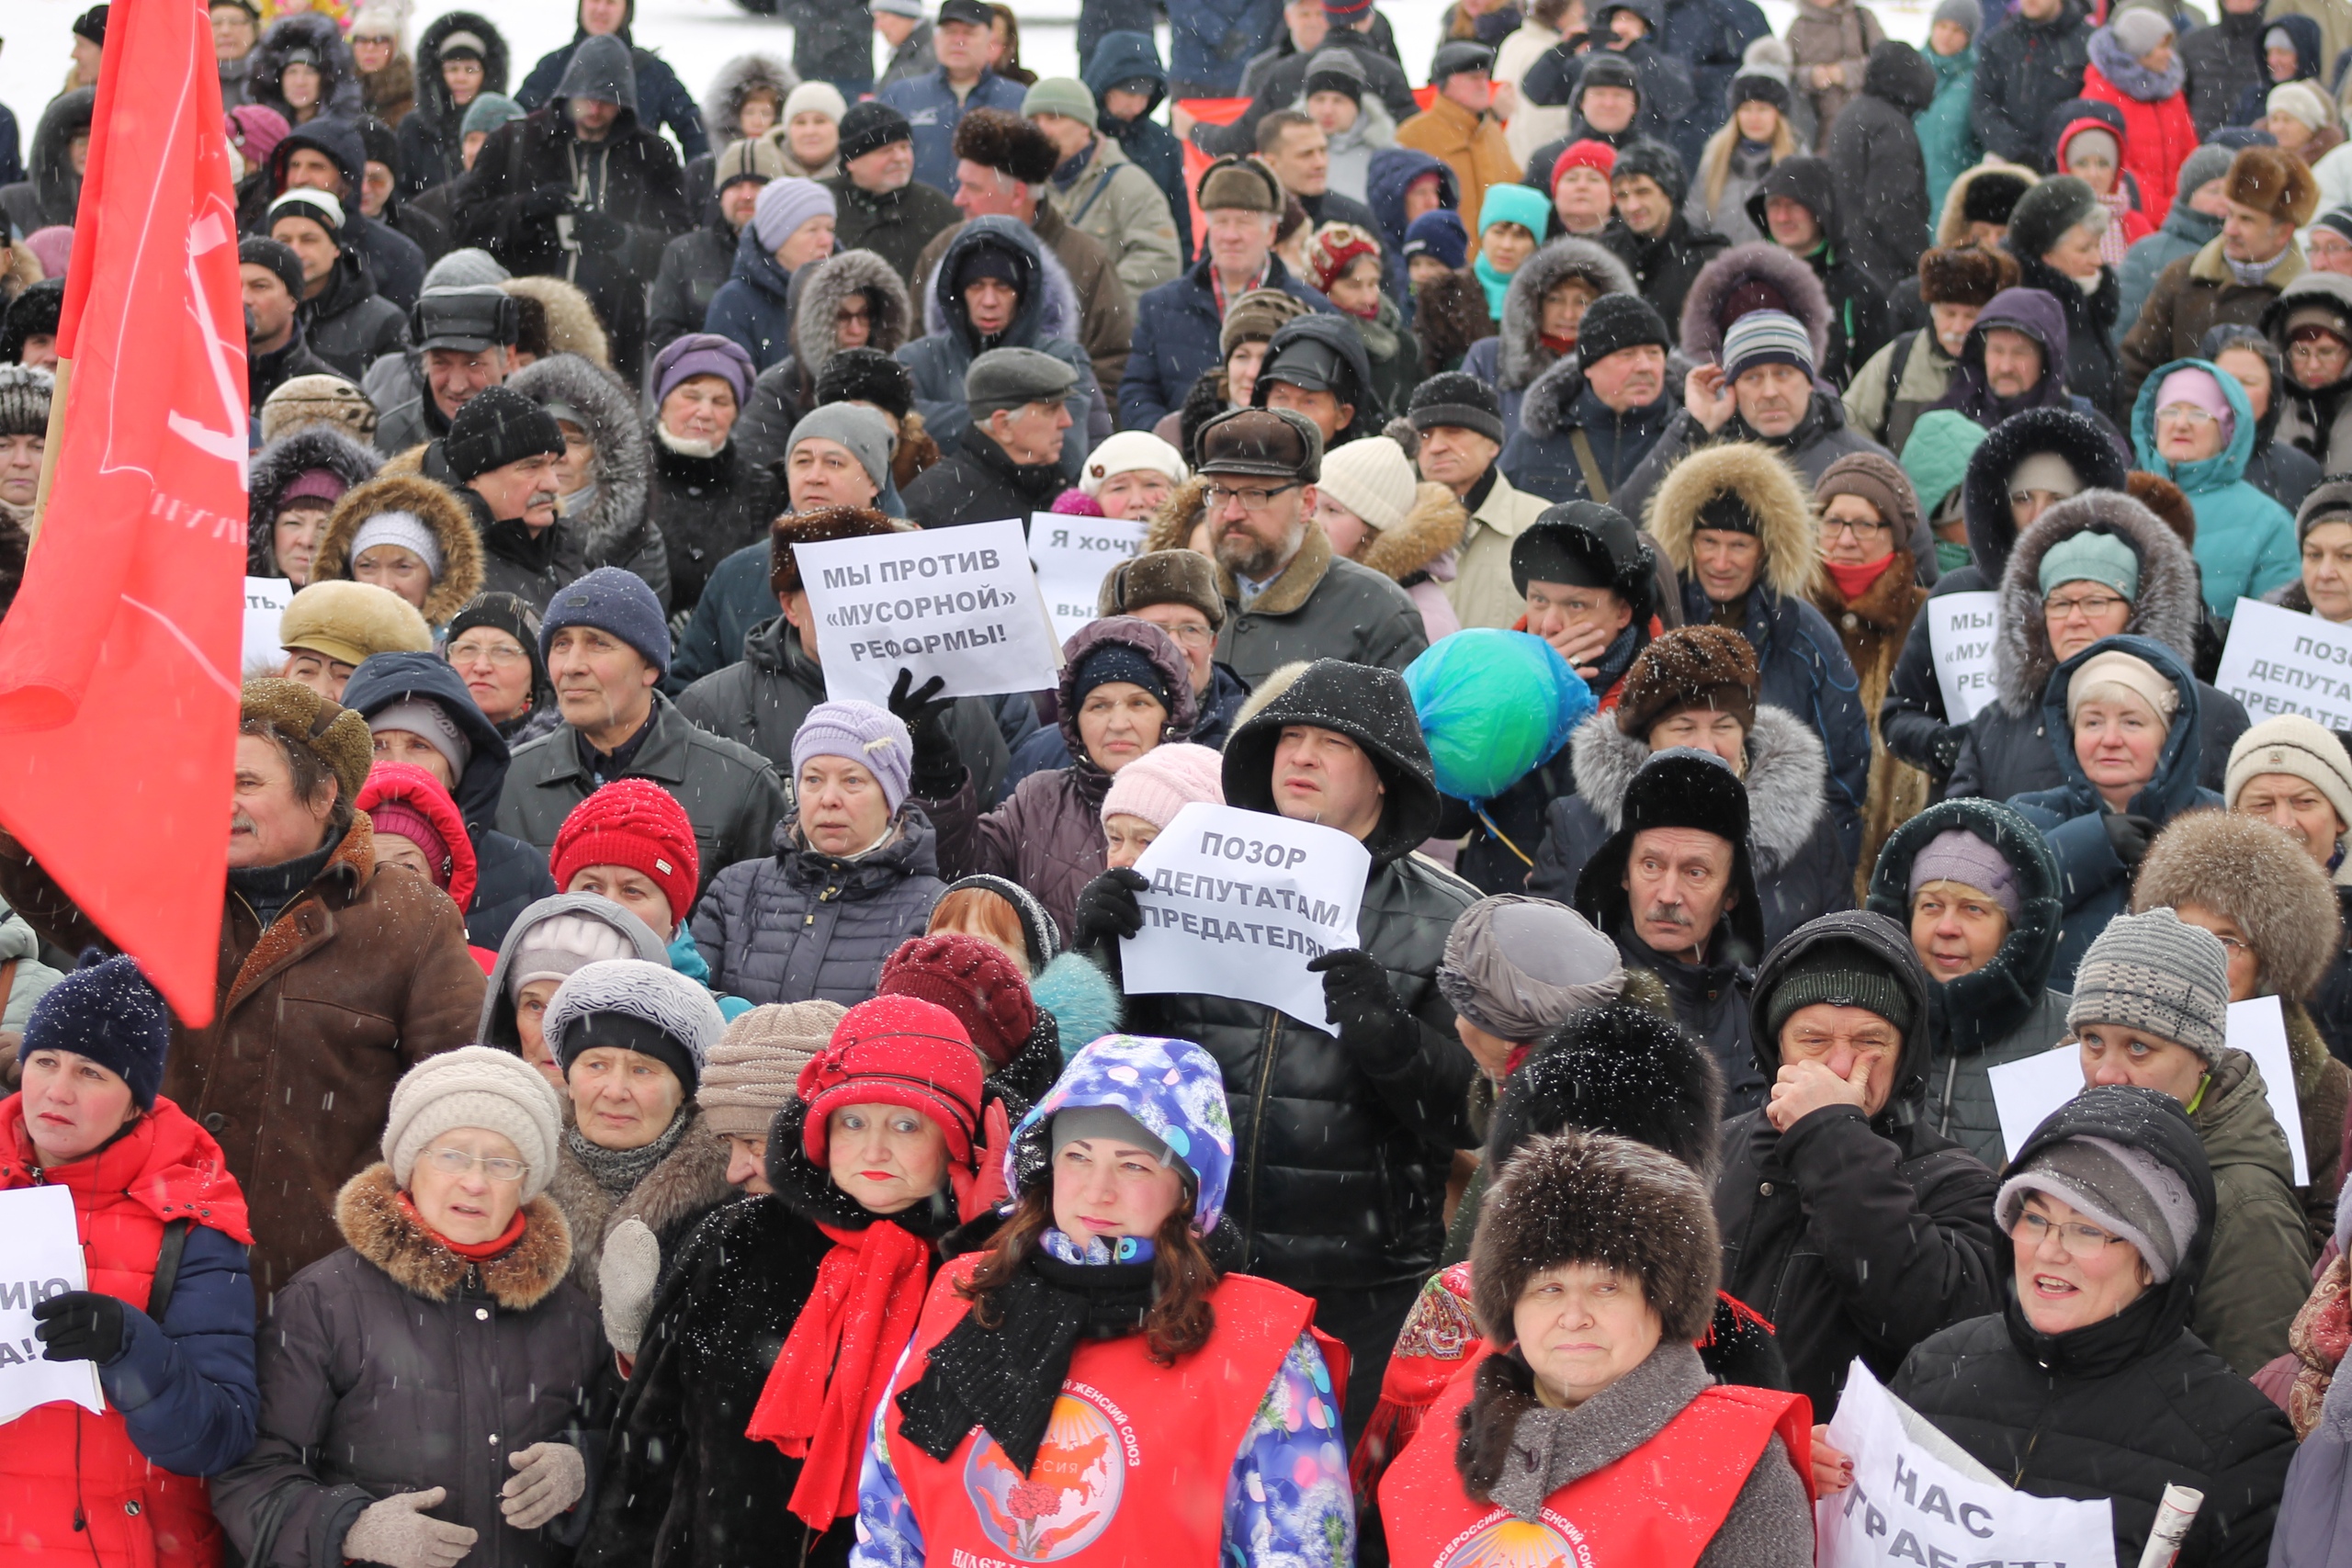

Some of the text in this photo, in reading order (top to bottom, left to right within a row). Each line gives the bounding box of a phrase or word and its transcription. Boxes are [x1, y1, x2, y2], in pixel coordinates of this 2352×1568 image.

[1050, 530, 1069, 547] Я
[822, 548, 1001, 589] МЫ ПРОТИВ
[826, 583, 1017, 626] «МУСОРНОЙ»
[1951, 613, 1993, 631] МЫ
[850, 624, 1007, 661] РЕФОРМЫ!
[2294, 635, 2352, 669] ПОЗ
[1200, 831, 1306, 870] ПОЗОР
[1149, 868, 1340, 928] ДЕПУТАТАМ
[1072, 1382, 1140, 1467] ЖЕНСКИЙ СОЮЗ
[1894, 1453, 1995, 1539] НАС
